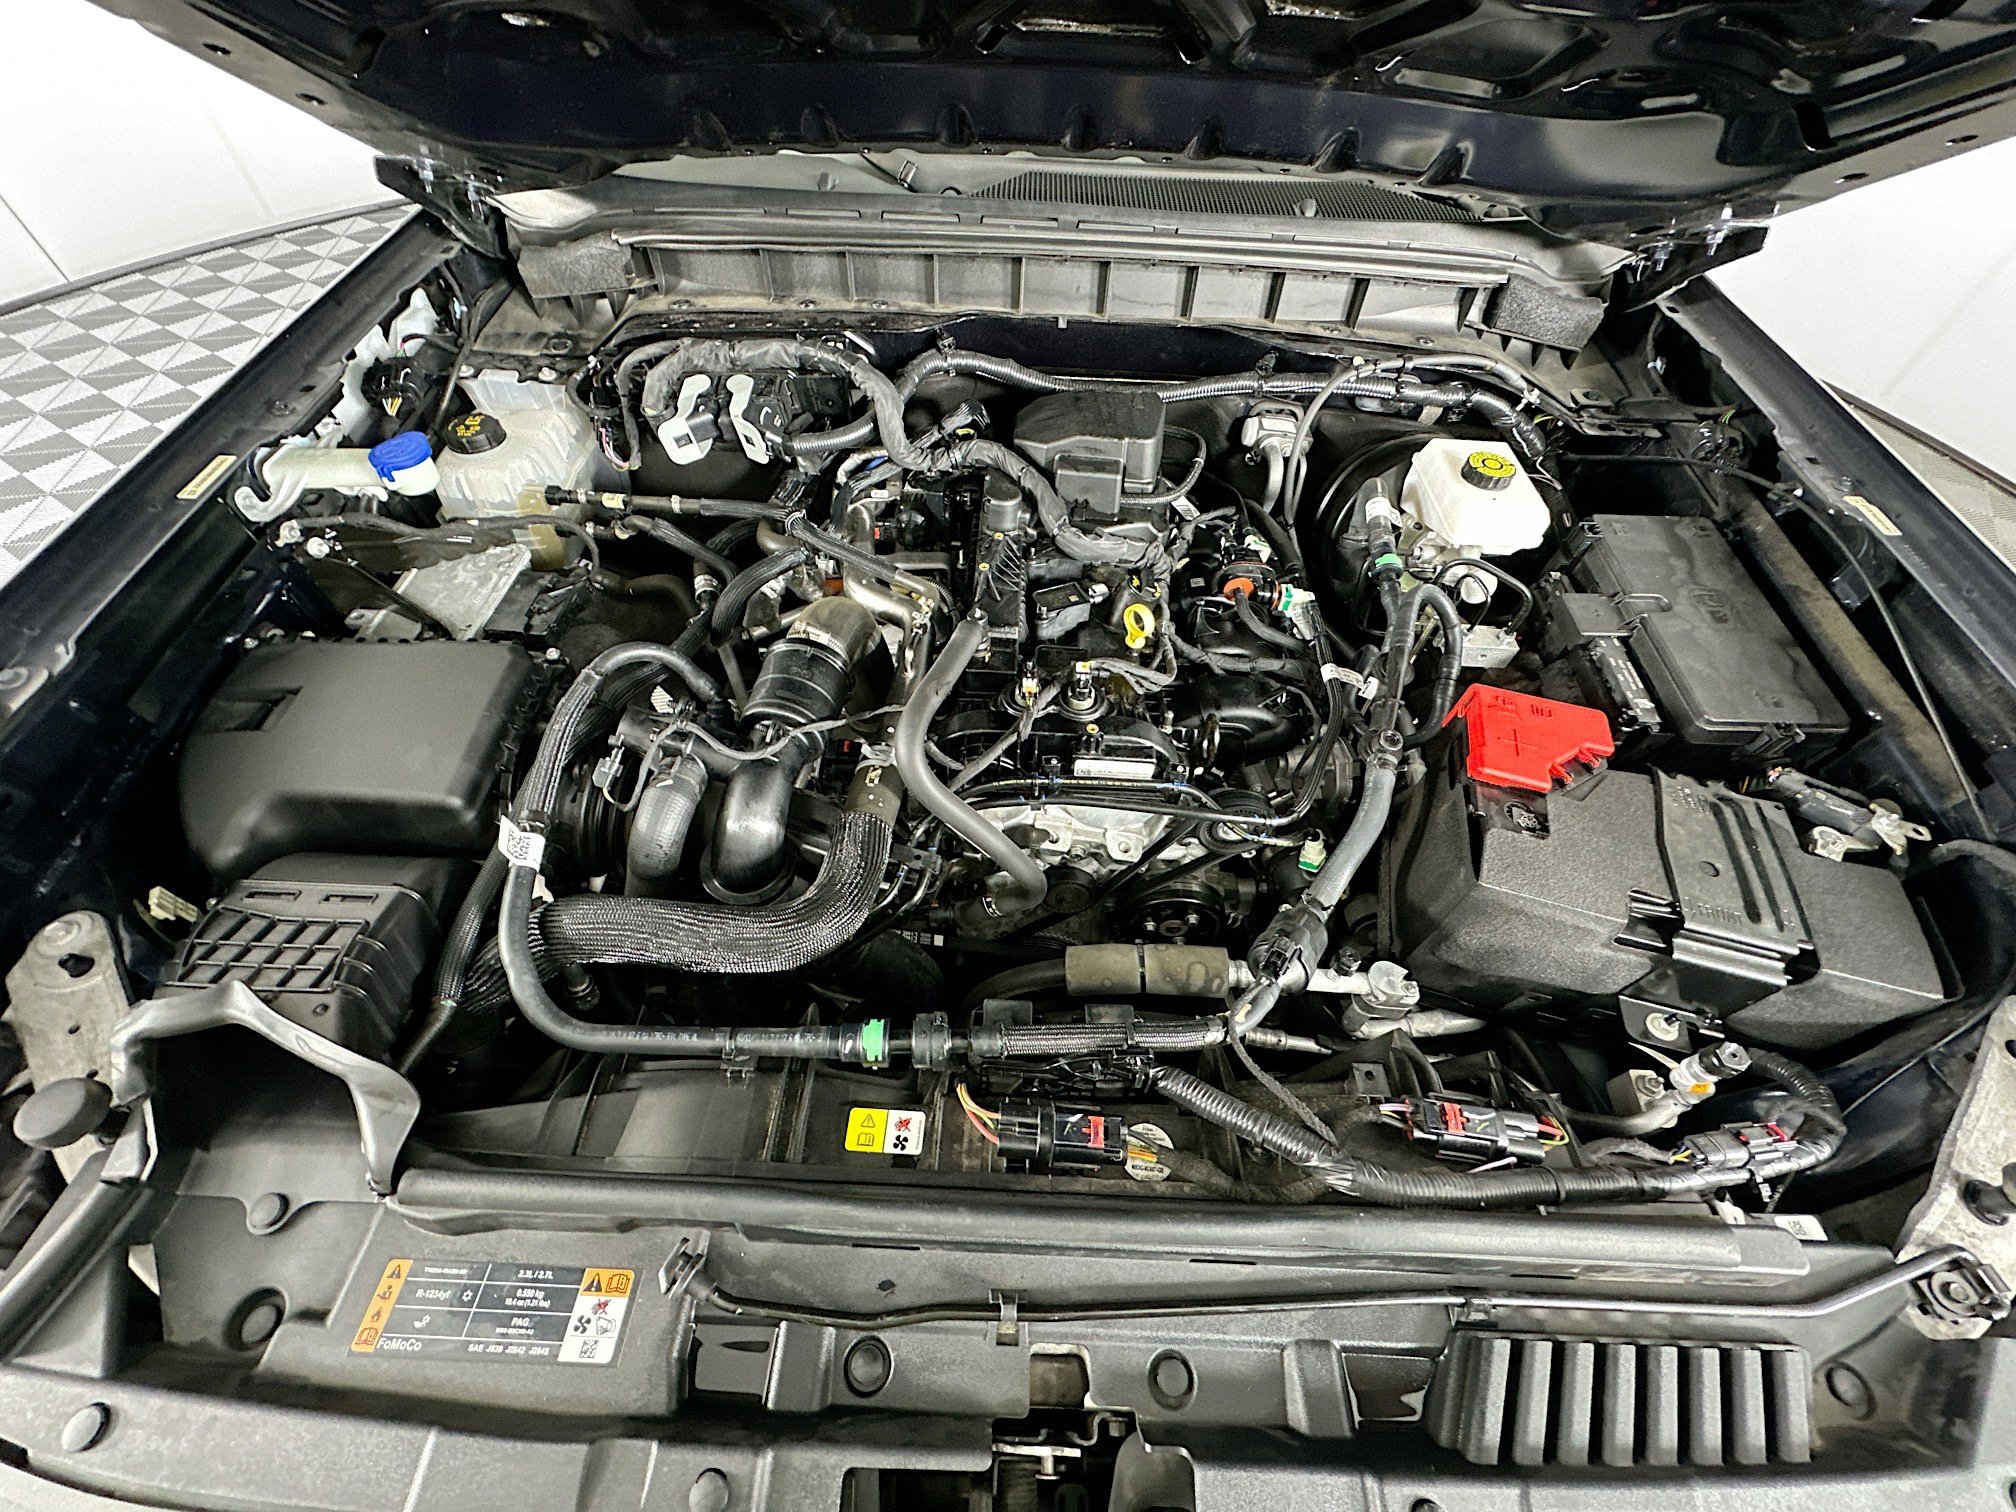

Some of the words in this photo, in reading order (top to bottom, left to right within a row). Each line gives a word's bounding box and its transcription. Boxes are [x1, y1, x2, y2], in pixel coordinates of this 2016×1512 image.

[415, 1288, 452, 1301] R-1234yf
[535, 1289, 545, 1300] kg
[511, 1317, 530, 1327] PAG
[376, 1337, 423, 1351] FoMoCo
[467, 1344, 485, 1352] SAE
